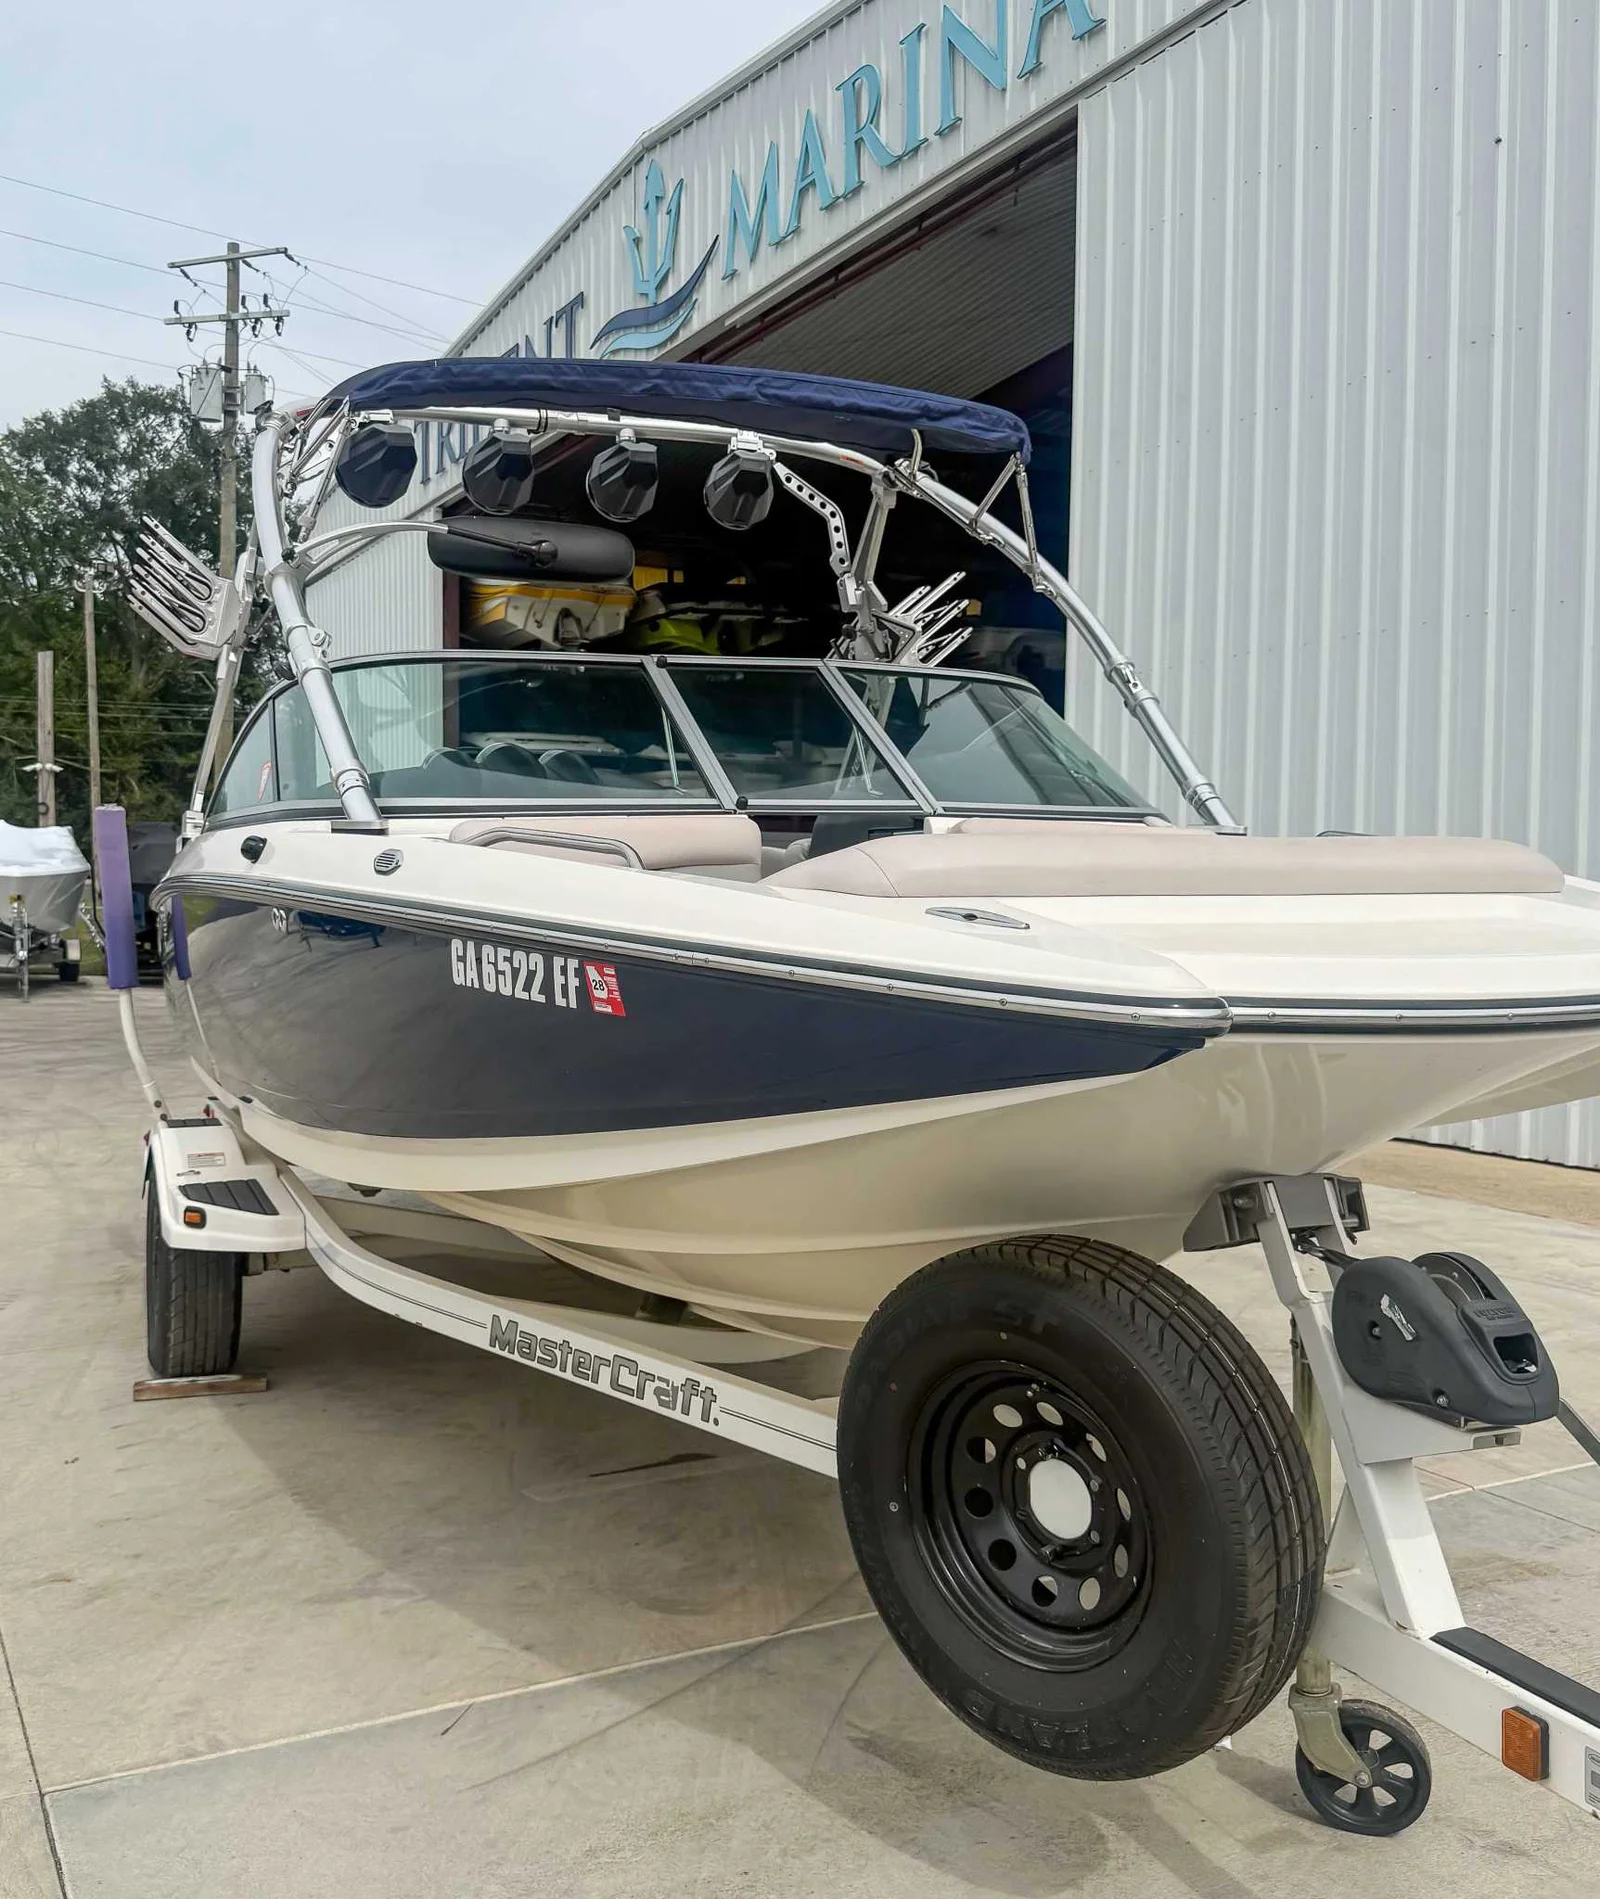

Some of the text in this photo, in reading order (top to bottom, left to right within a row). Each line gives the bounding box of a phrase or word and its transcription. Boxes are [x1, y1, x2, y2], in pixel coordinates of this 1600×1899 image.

[721, 0, 1107, 281] MARINA
[451, 938, 480, 989] GA
[481, 944, 547, 1003] 6522
[553, 956, 580, 1009] EF
[591, 978, 606, 992] 28
